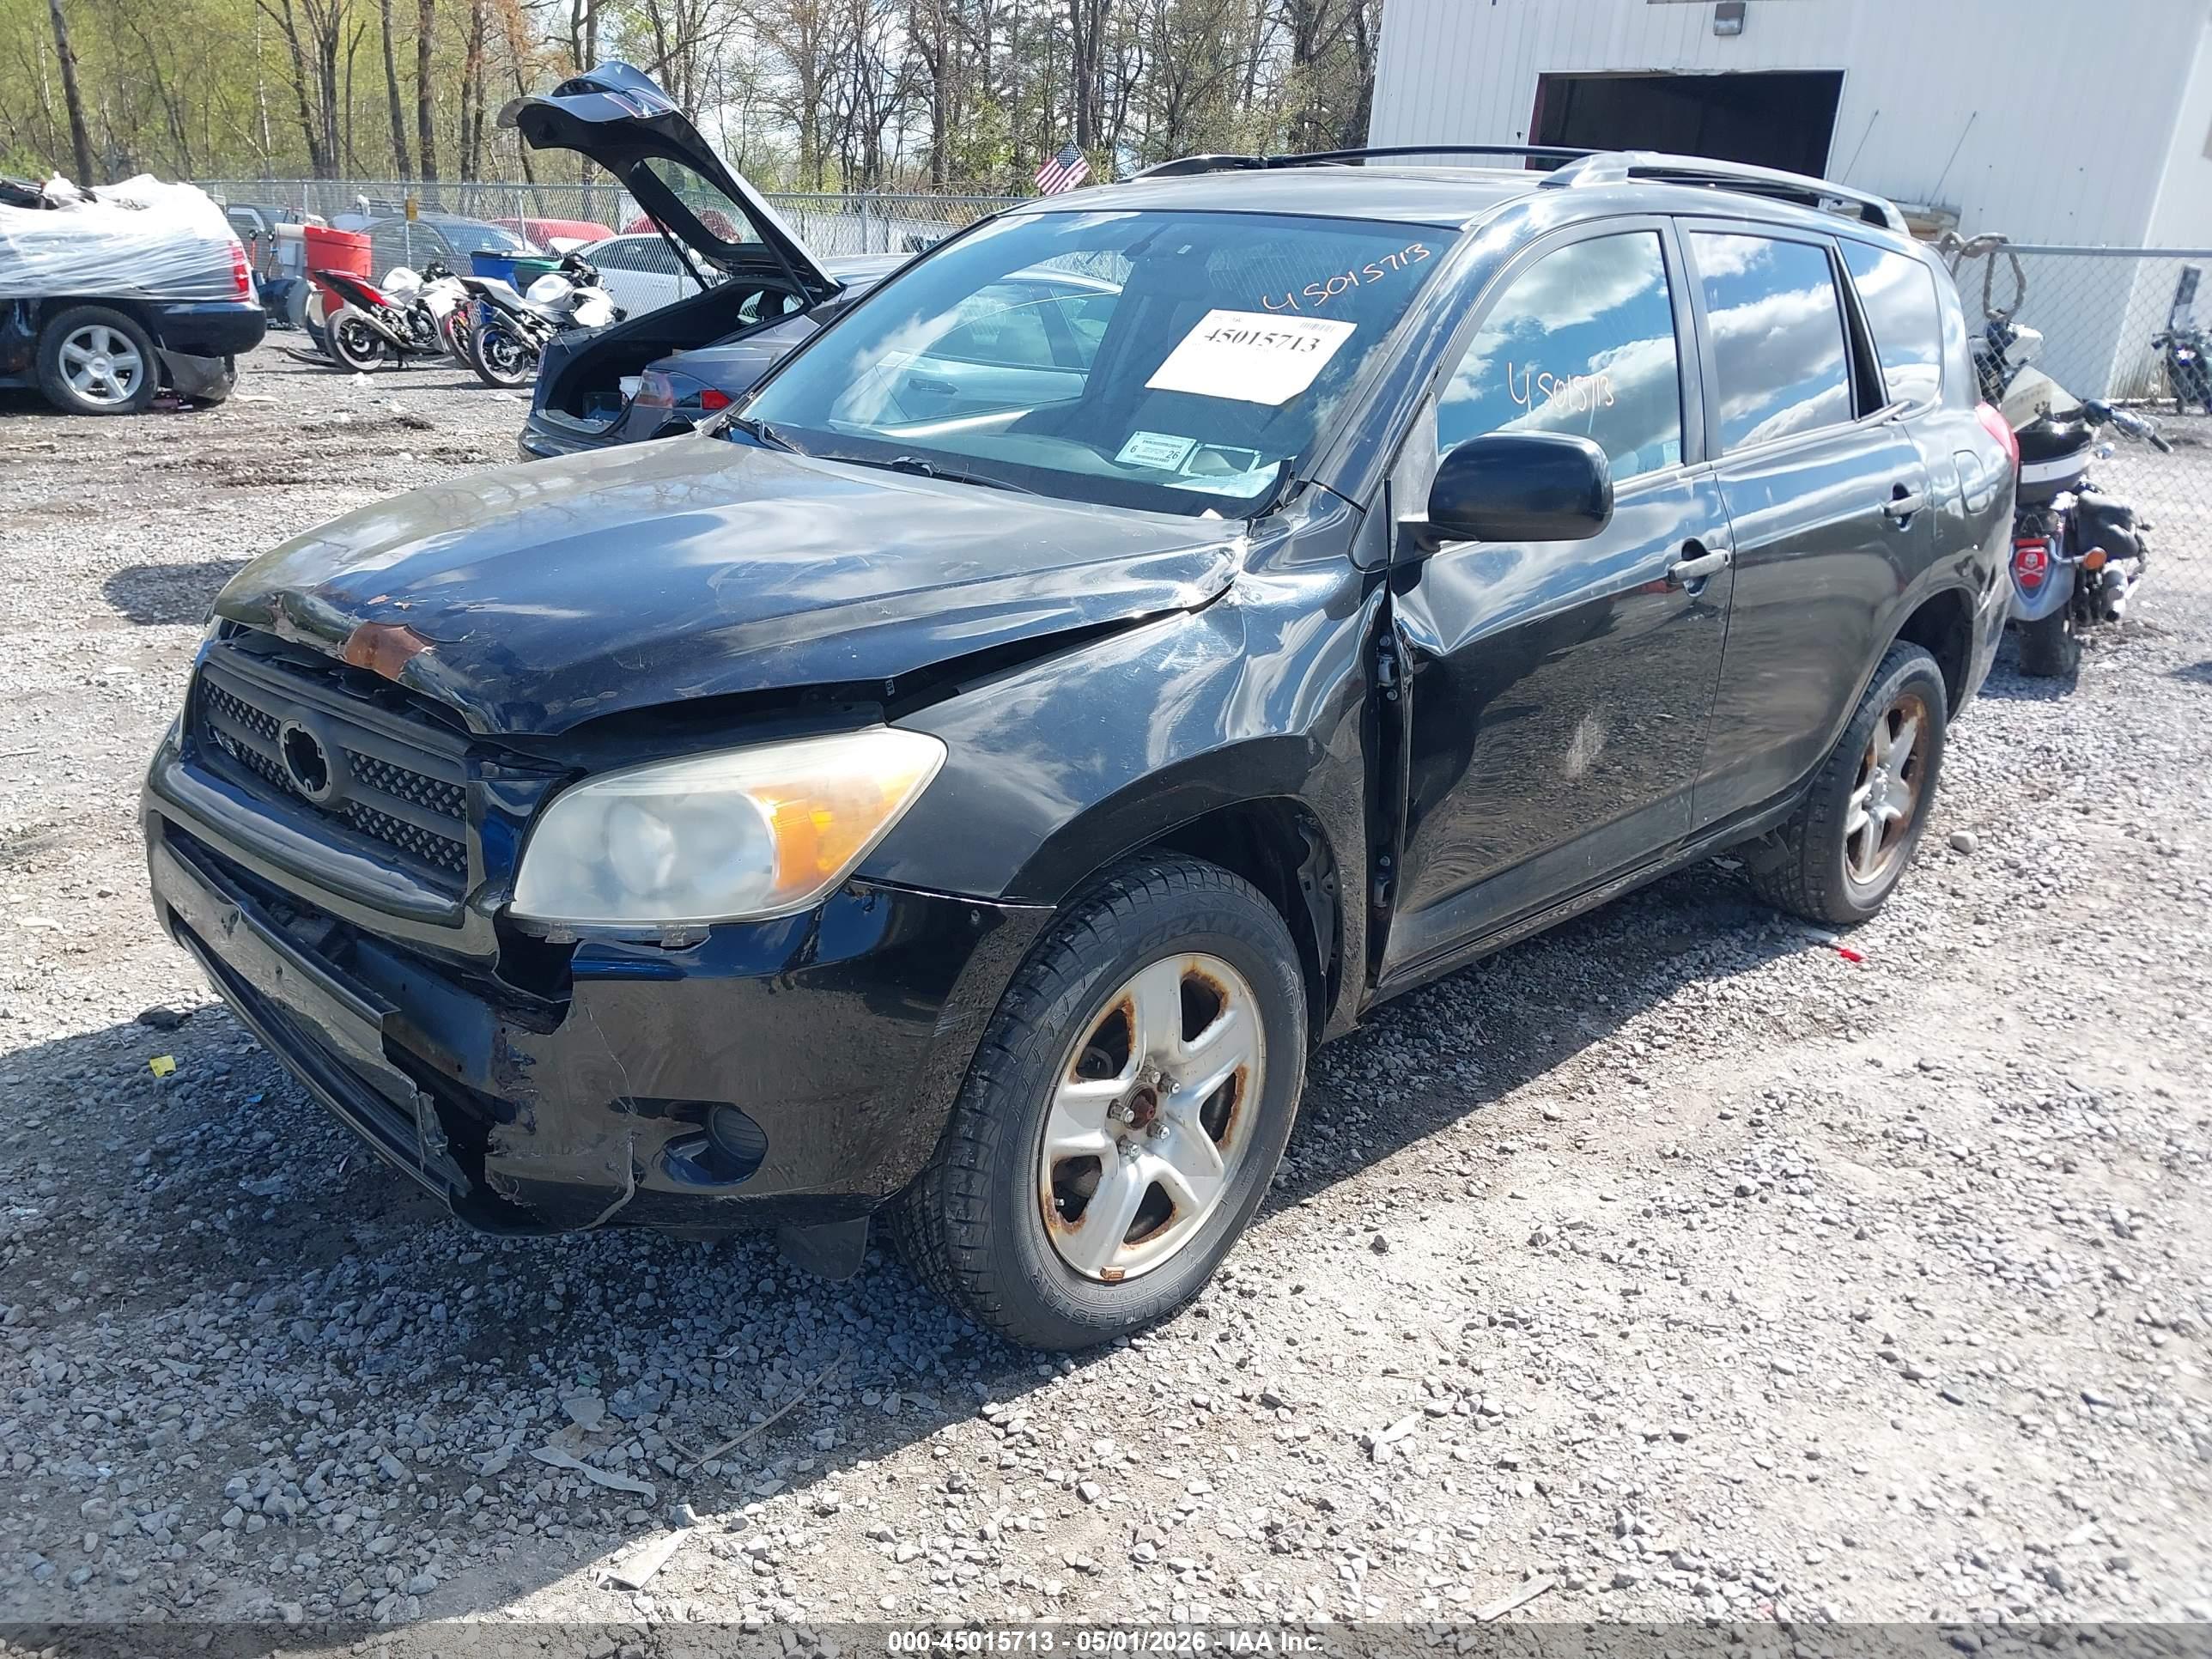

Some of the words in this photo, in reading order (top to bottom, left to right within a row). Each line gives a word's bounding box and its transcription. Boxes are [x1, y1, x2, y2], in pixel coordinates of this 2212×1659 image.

[1204, 328, 1321, 353] 45015713
[1129, 445, 1139, 454] 6
[1166, 450, 1182, 460] 26
[1030, 1267, 1155, 1330] MILESTAR
